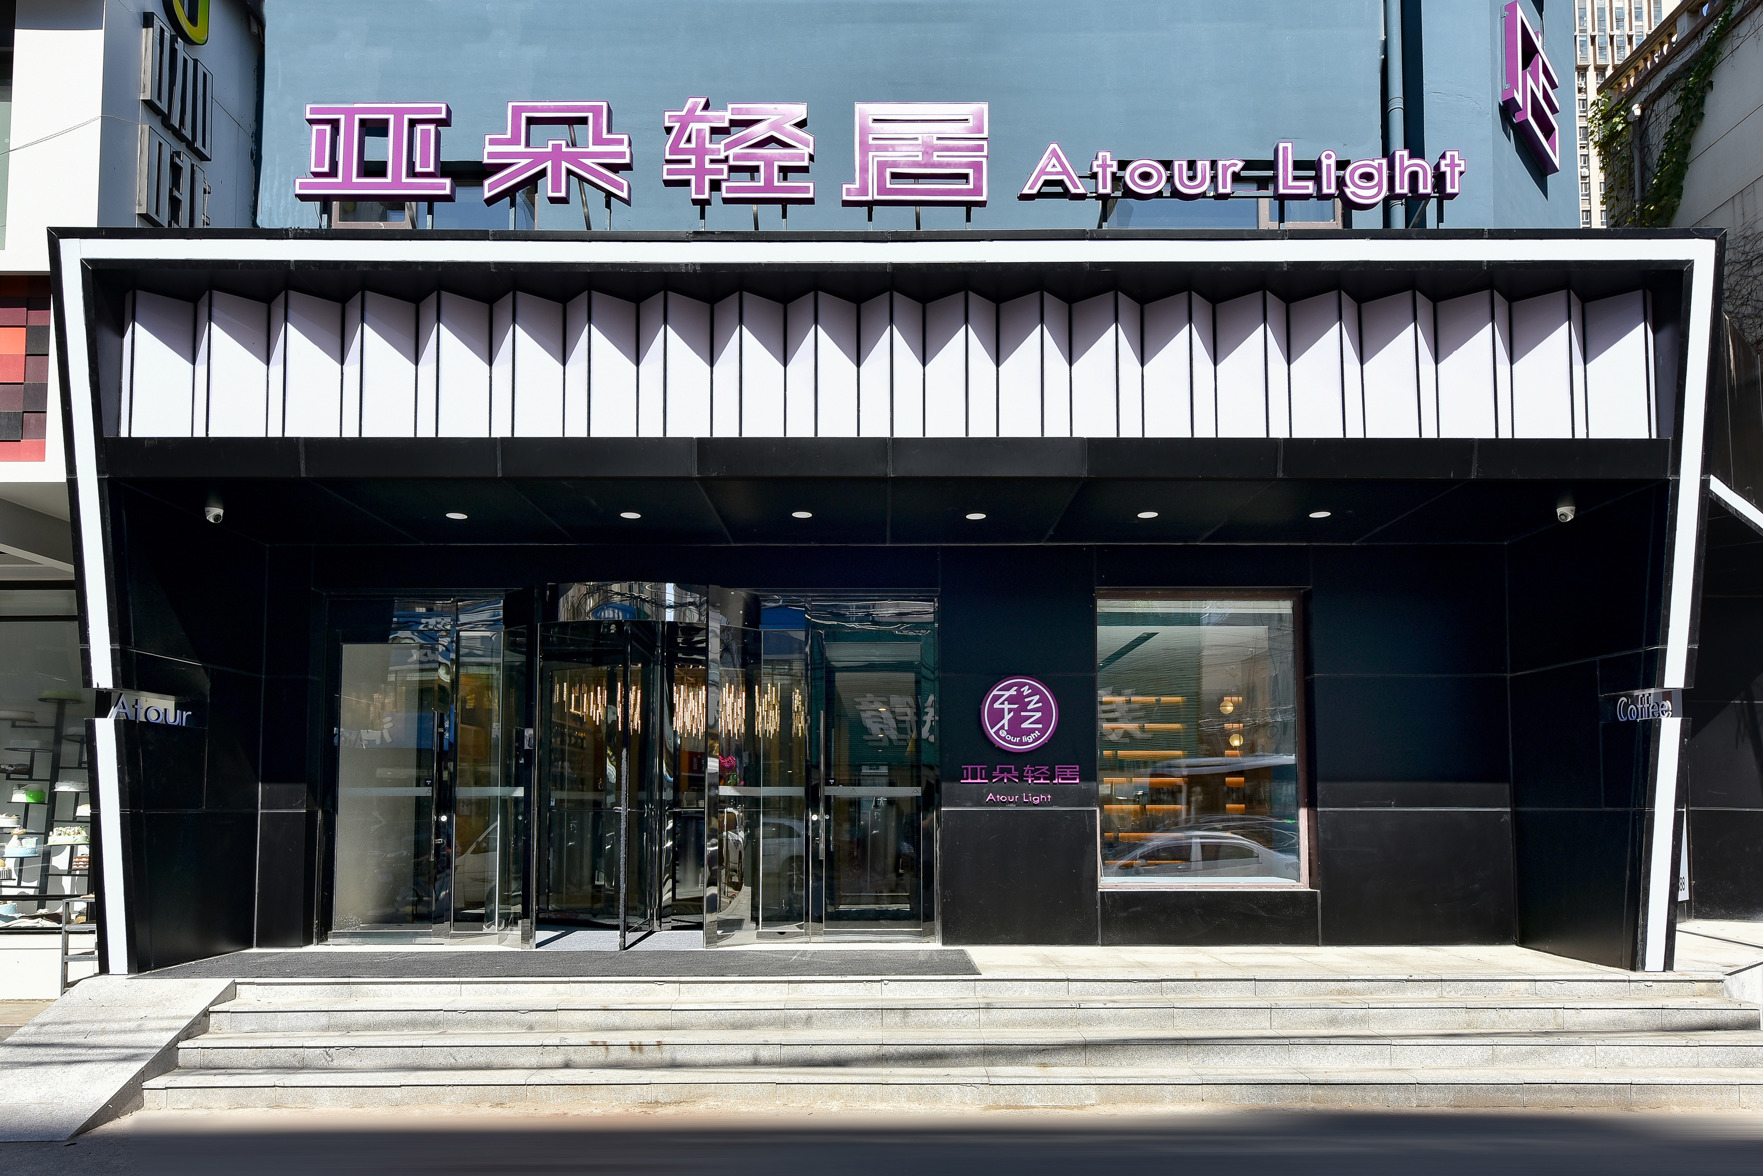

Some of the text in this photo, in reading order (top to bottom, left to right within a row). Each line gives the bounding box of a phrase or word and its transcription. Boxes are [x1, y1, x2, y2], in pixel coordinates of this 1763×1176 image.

[294, 97, 988, 207] 亚朵轻居
[1019, 141, 1467, 210] Atour Light
[107, 692, 192, 727] Atour
[1616, 692, 1673, 721] Coffee
[960, 764, 1080, 784] 亚朵轻居
[985, 792, 1052, 804] Atour Light
